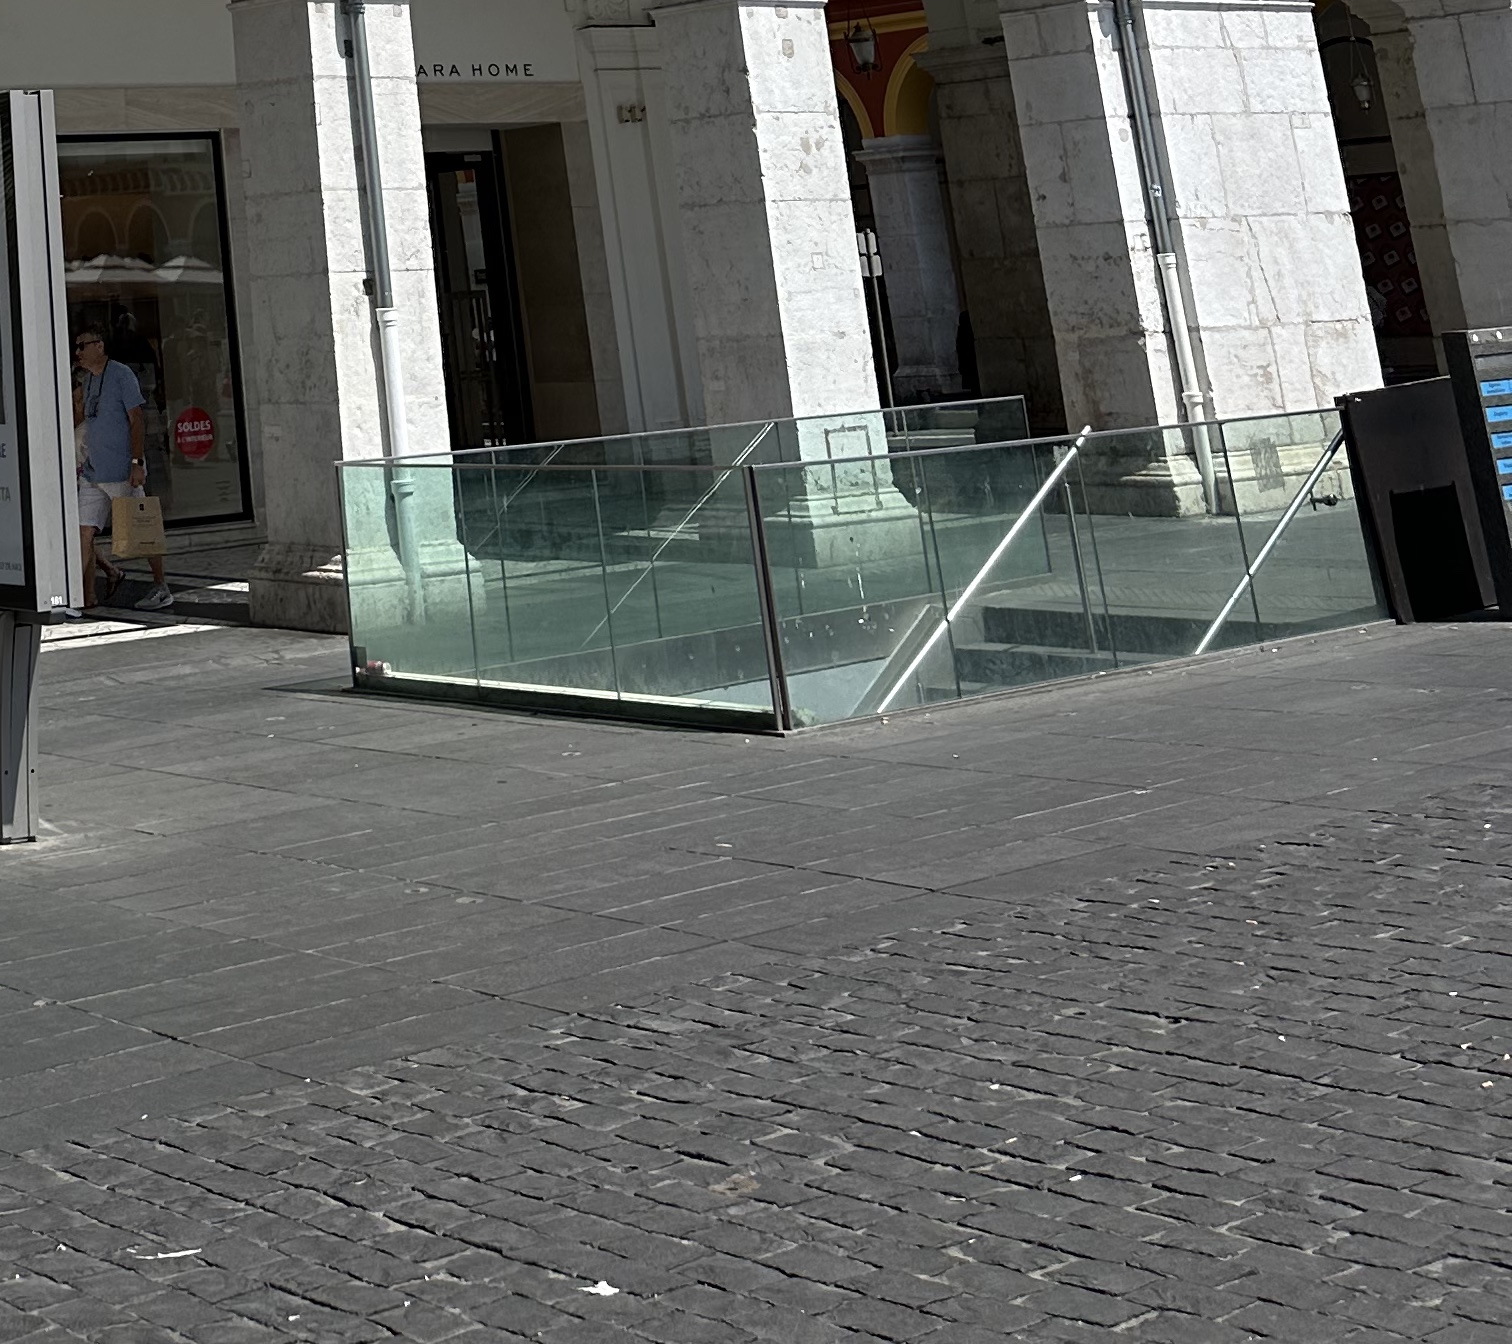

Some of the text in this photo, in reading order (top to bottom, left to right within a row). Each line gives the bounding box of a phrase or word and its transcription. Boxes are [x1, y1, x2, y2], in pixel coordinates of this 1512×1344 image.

[417, 63, 534, 77] ARA HOME
[177, 419, 211, 433] SOLDES
